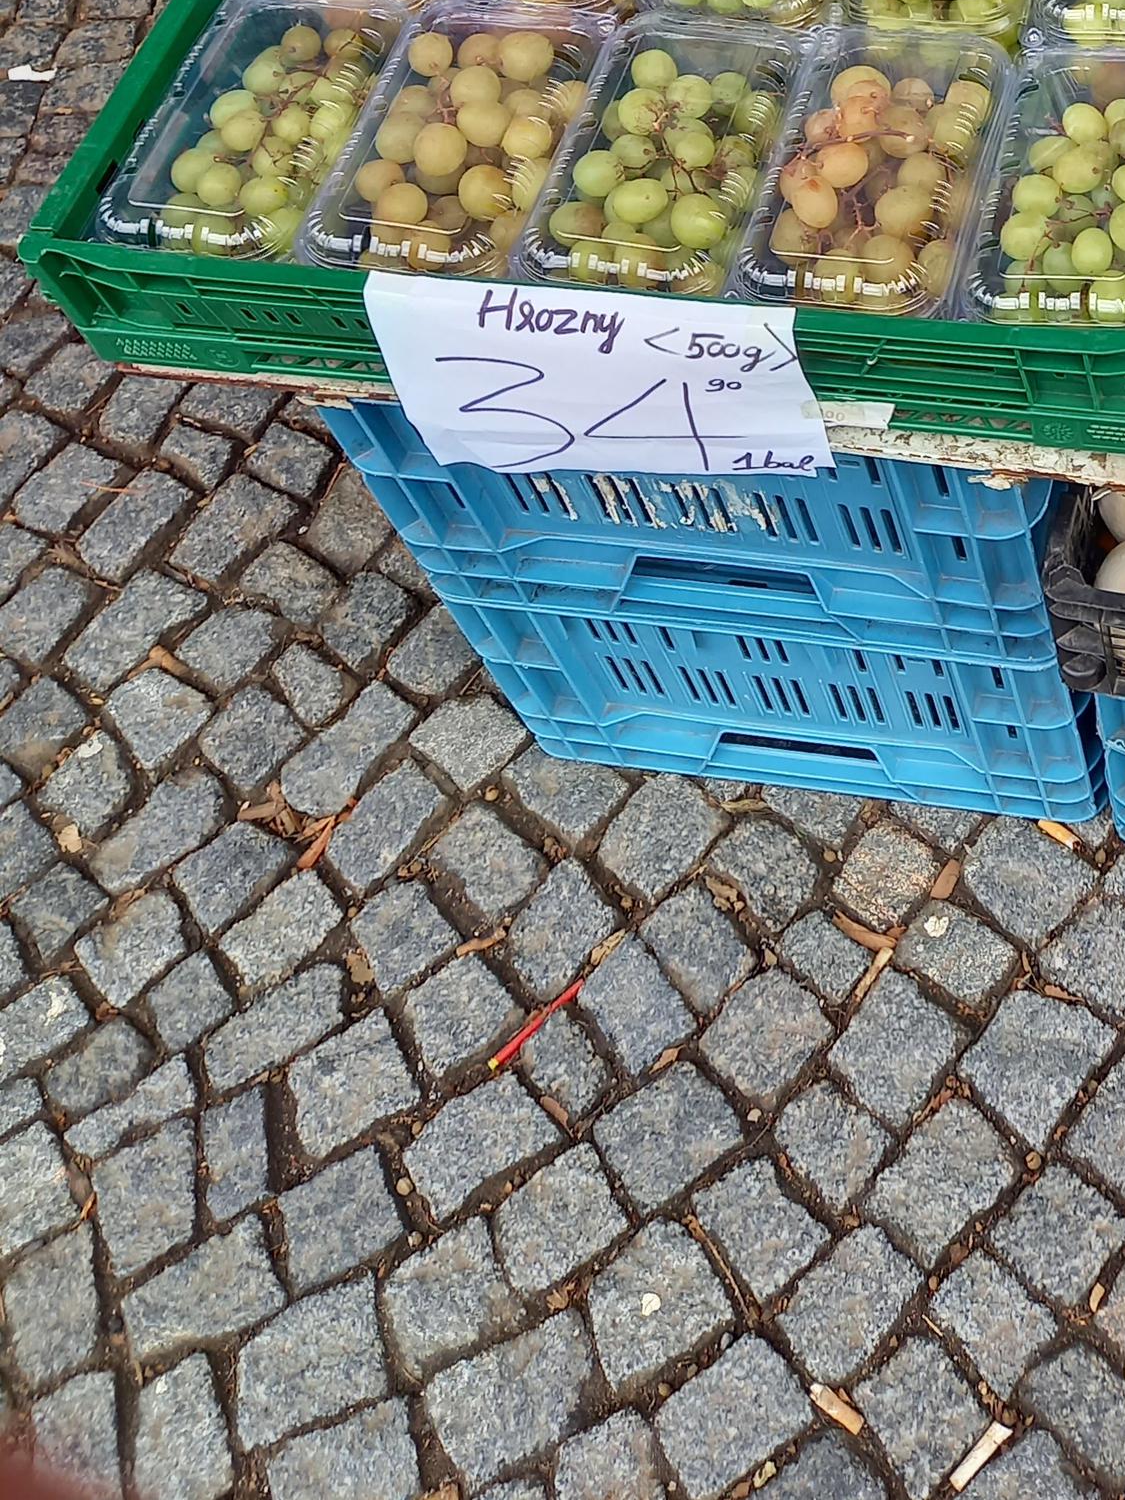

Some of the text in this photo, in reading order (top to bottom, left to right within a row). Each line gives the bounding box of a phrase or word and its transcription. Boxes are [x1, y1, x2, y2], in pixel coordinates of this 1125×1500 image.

[476, 288, 627, 354] Hrozny
[435, 356, 748, 472] 34 90
